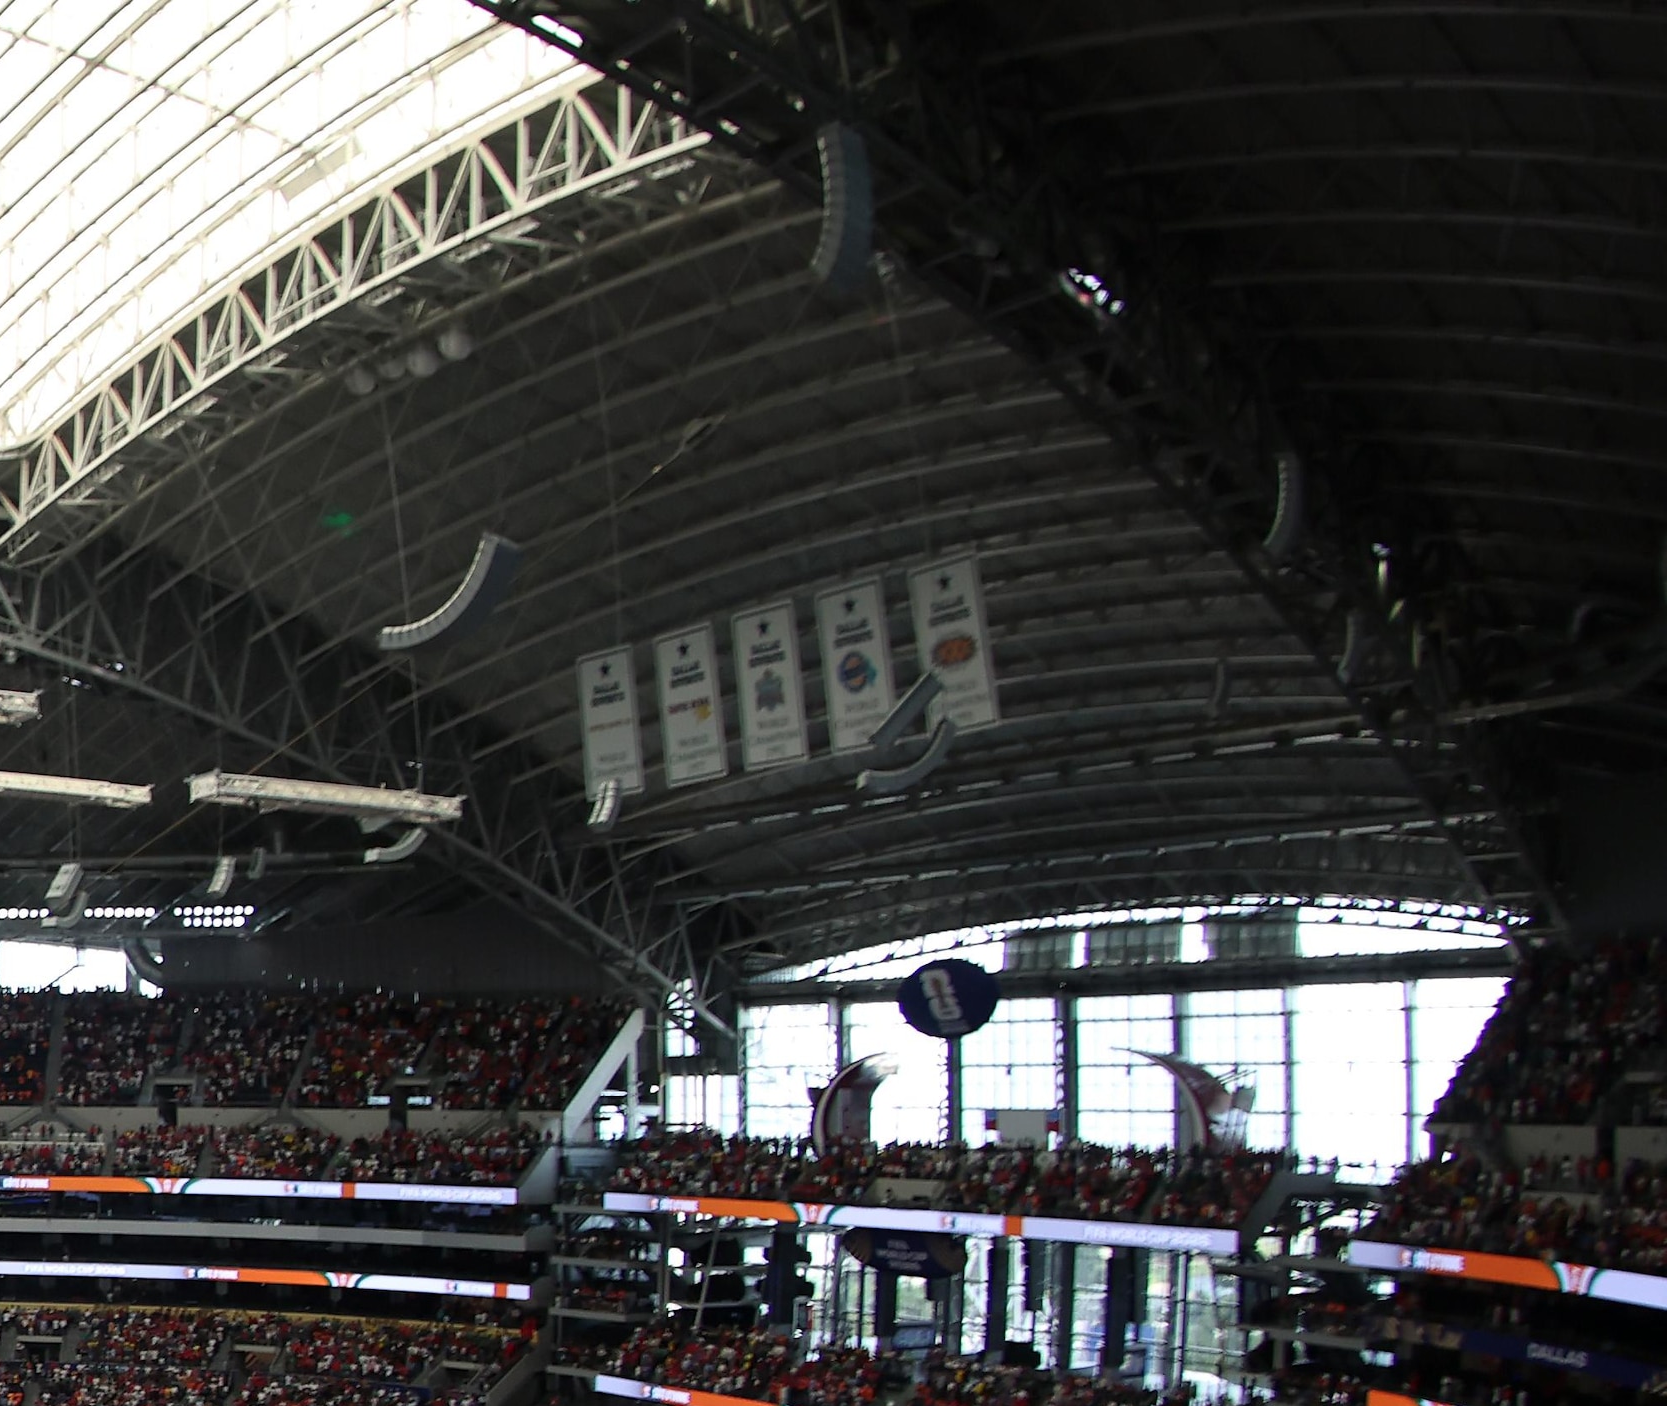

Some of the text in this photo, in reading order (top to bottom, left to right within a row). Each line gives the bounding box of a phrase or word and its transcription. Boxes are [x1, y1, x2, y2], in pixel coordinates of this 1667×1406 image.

[25, 1263, 125, 1275] FIFA WORLD CUP 2026
